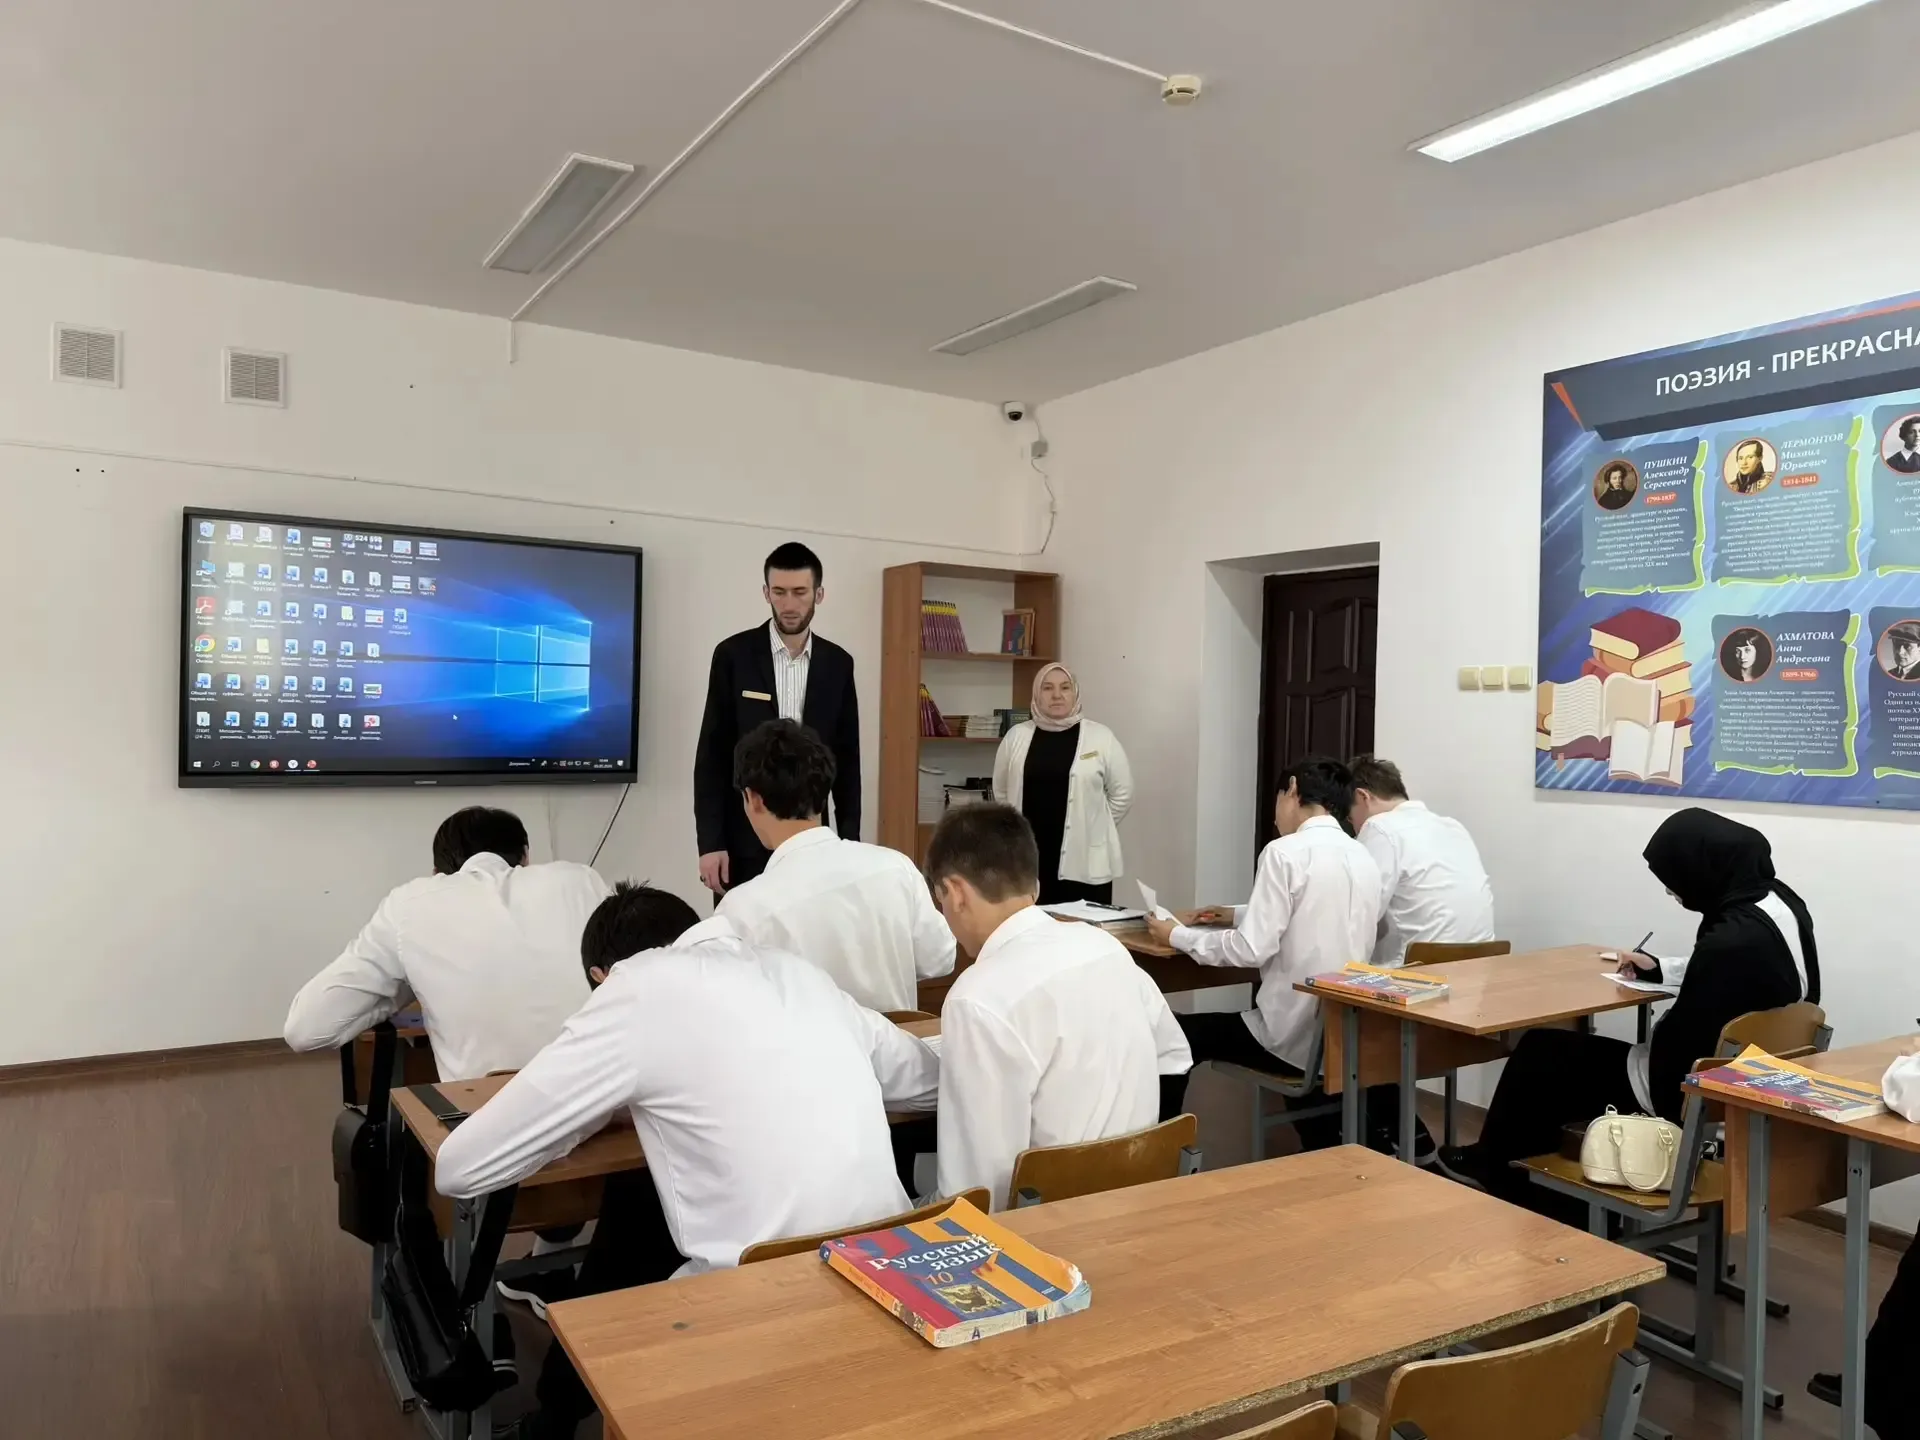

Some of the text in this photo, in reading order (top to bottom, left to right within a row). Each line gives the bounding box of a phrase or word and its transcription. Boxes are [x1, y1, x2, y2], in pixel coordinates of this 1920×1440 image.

[1656, 360, 1750, 396] ПОЭЗИЯ
[1781, 434, 1844, 450] ЛЕРМОНТОВ
[1782, 448, 1820, 460] Михаил
[1644, 456, 1688, 470] ПУШКИН
[1780, 460, 1828, 472] Юрьевич
[1644, 467, 1690, 480] Александр
[1644, 478, 1686, 490] Сергеевич
[1782, 477, 1816, 485] 1814-1841
[1646, 494, 1676, 503] 1799-1837
[1776, 632, 1834, 641] АХМАТОВА
[1776, 654, 1830, 665] Андреевна
[1888, 690, 1916, 698] Русский
[865, 1233, 990, 1271] Русский
[930, 1242, 1003, 1271] язык
[926, 1271, 954, 1286] 10
